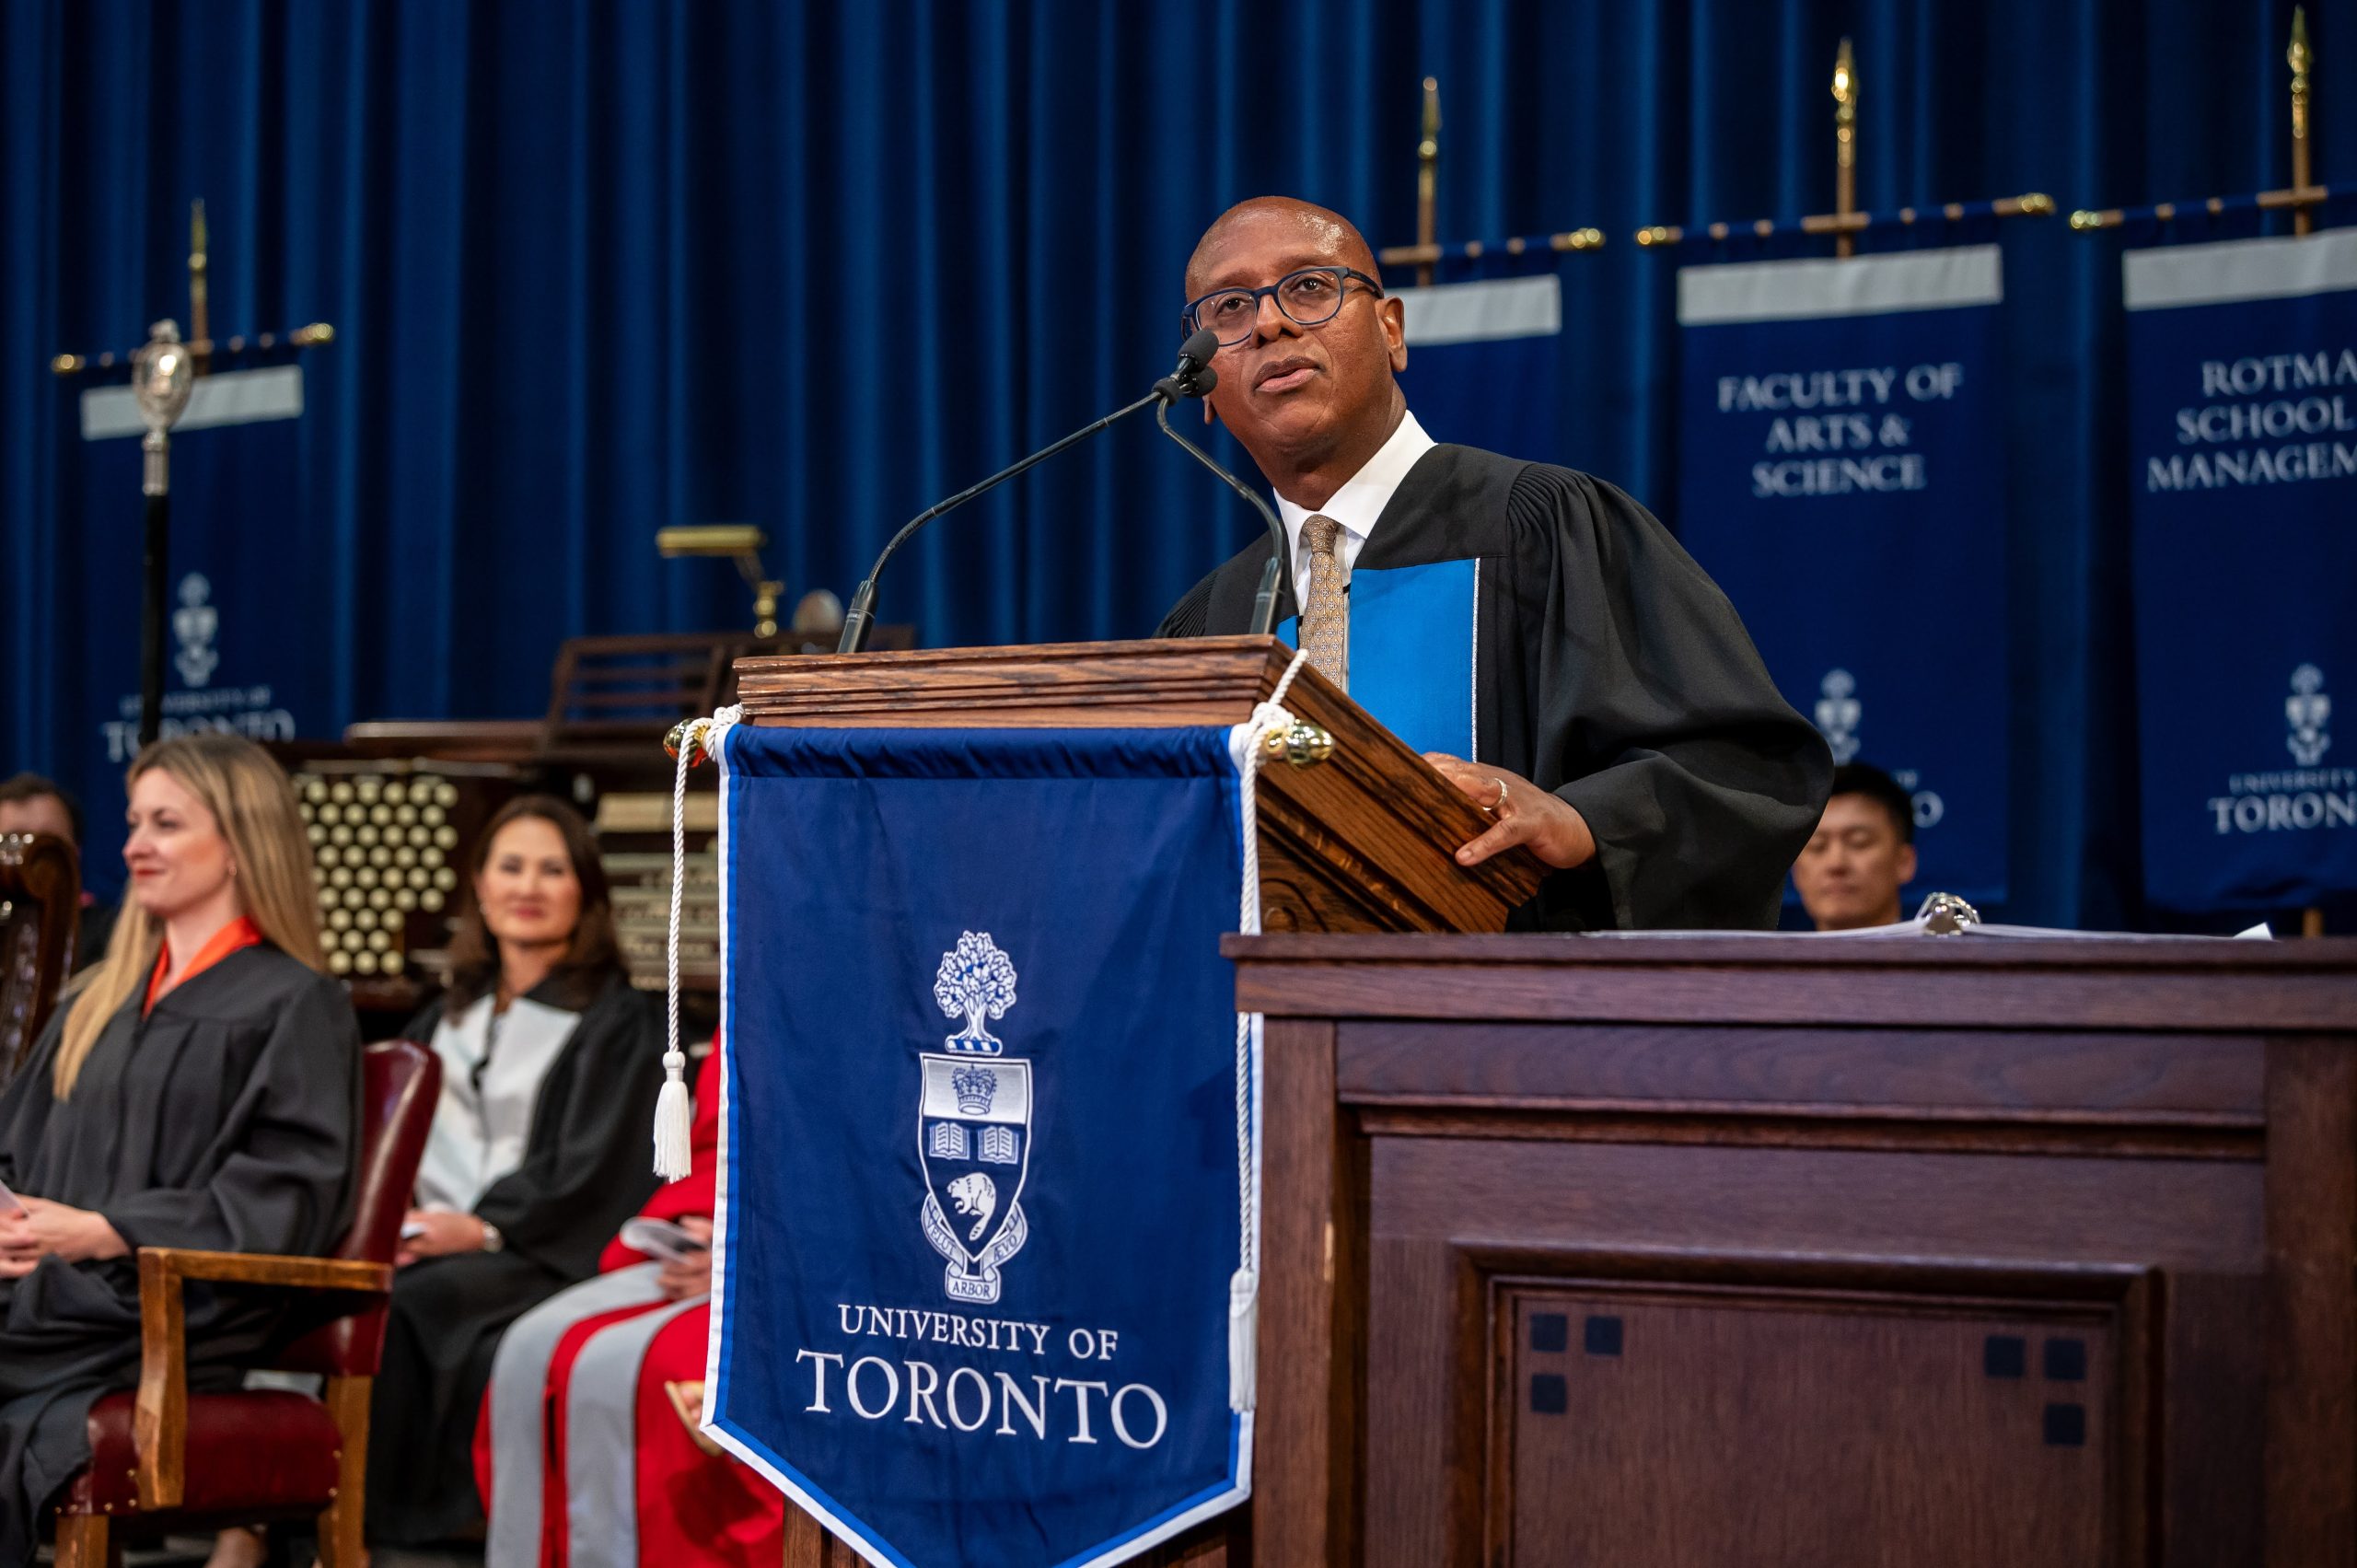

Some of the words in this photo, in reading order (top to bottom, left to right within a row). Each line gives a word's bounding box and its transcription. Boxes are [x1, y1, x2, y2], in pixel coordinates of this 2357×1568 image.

[1718, 367, 1896, 412] FACULTY
[1905, 362, 1964, 401] OF
[2201, 348, 2357, 398] ROTMA
[1765, 413, 1873, 453] ARTS
[1878, 413, 1912, 447] &
[2176, 395, 2356, 446] SCHOOL
[1752, 454, 1928, 498] SCIENCE
[2147, 440, 2357, 494] MANAGEM
[2207, 791, 2357, 834] TORON
[952, 1281, 991, 1298] ARBOR
[838, 1304, 1051, 1355] UNIVERSITY
[1069, 1329, 1118, 1360] OF
[795, 1349, 1167, 1449] TORONTO
